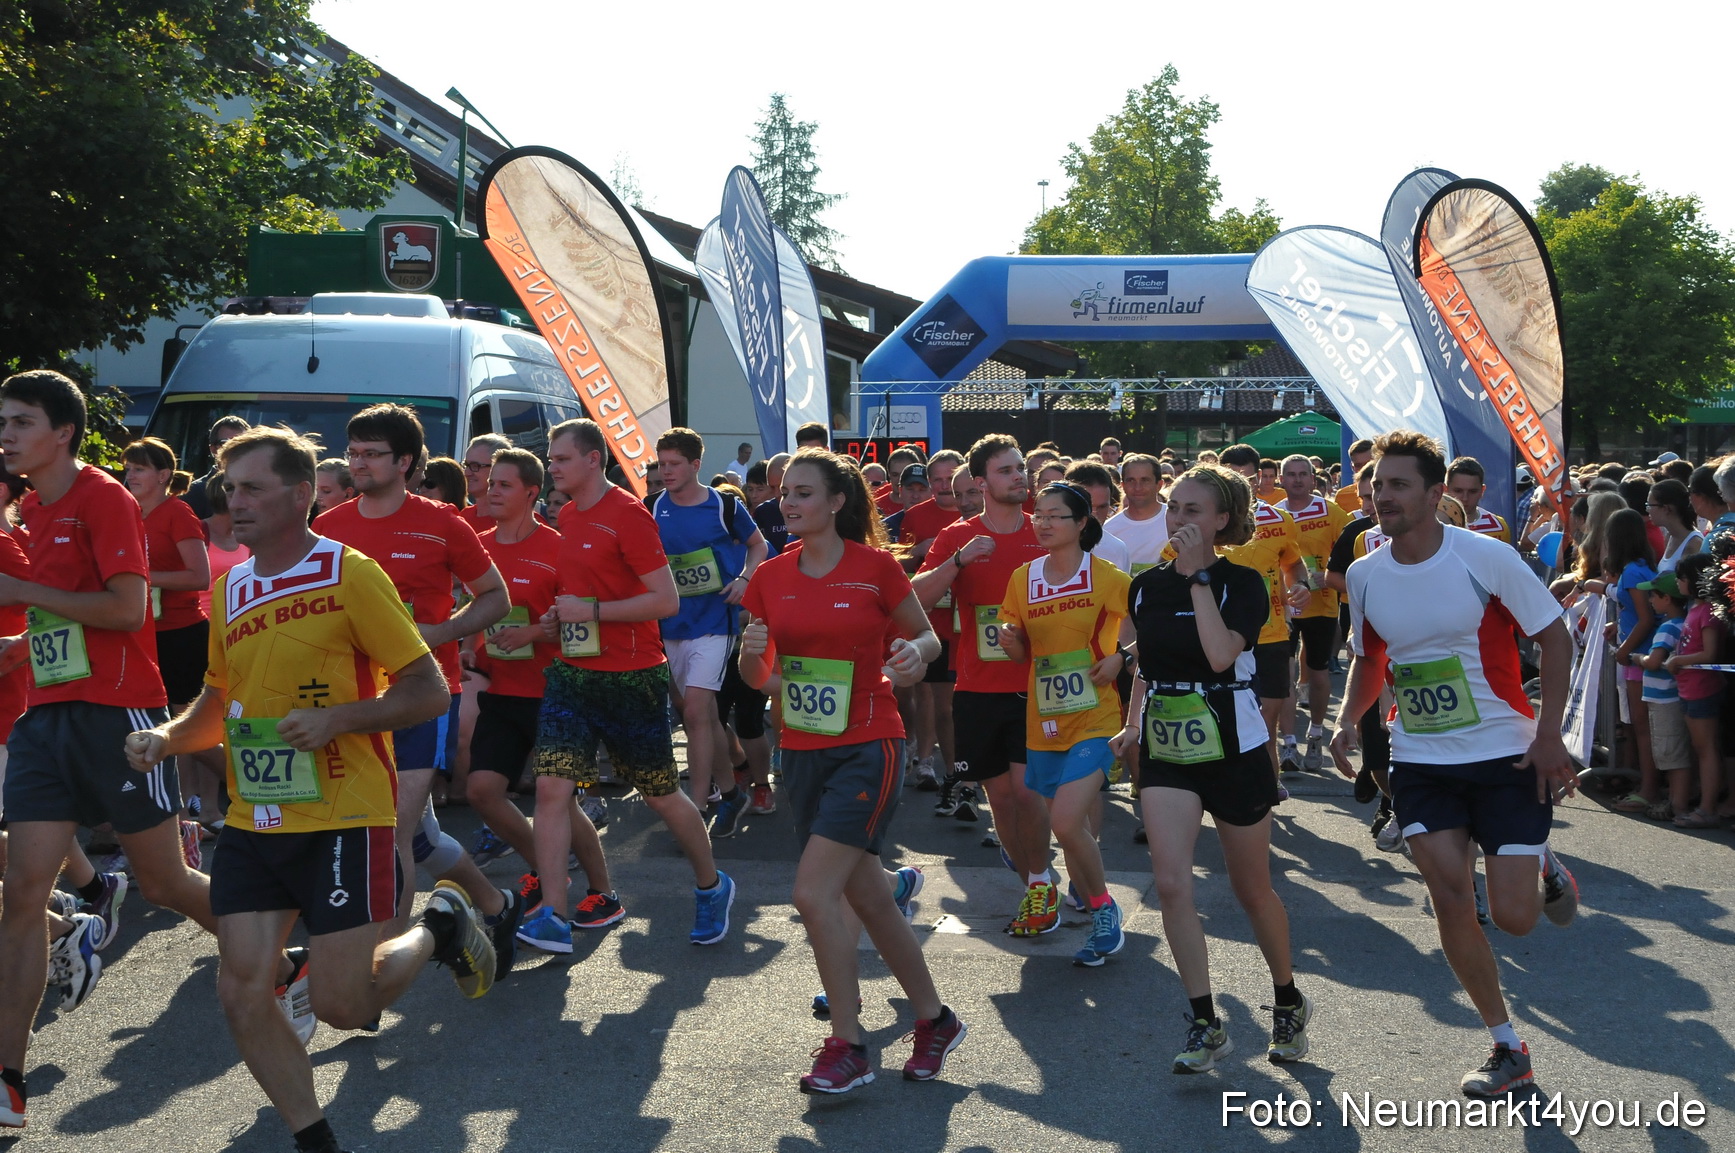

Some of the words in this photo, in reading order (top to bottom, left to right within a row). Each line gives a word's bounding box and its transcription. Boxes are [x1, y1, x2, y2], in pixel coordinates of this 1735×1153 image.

[398, 275, 423, 286] 1628
[1133, 279, 1165, 287] Fischer
[1107, 295, 1206, 314] firmenlauf
[923, 328, 975, 341] Fischer
[1300, 519, 1331, 532] BÖGL
[675, 565, 711, 587] 639
[1028, 604, 1055, 620] MAX
[1059, 598, 1095, 612] BÖGL
[226, 613, 269, 651] MAX
[275, 595, 345, 625] BÖGL
[31, 628, 70, 667] 937
[787, 682, 837, 716] 936
[1040, 672, 1084, 701] 790
[1403, 684, 1459, 716] 309
[1151, 719, 1207, 747] 976
[240, 748, 296, 784] 827
[334, 835, 344, 855] riders
[334, 855, 343, 886] pacific
